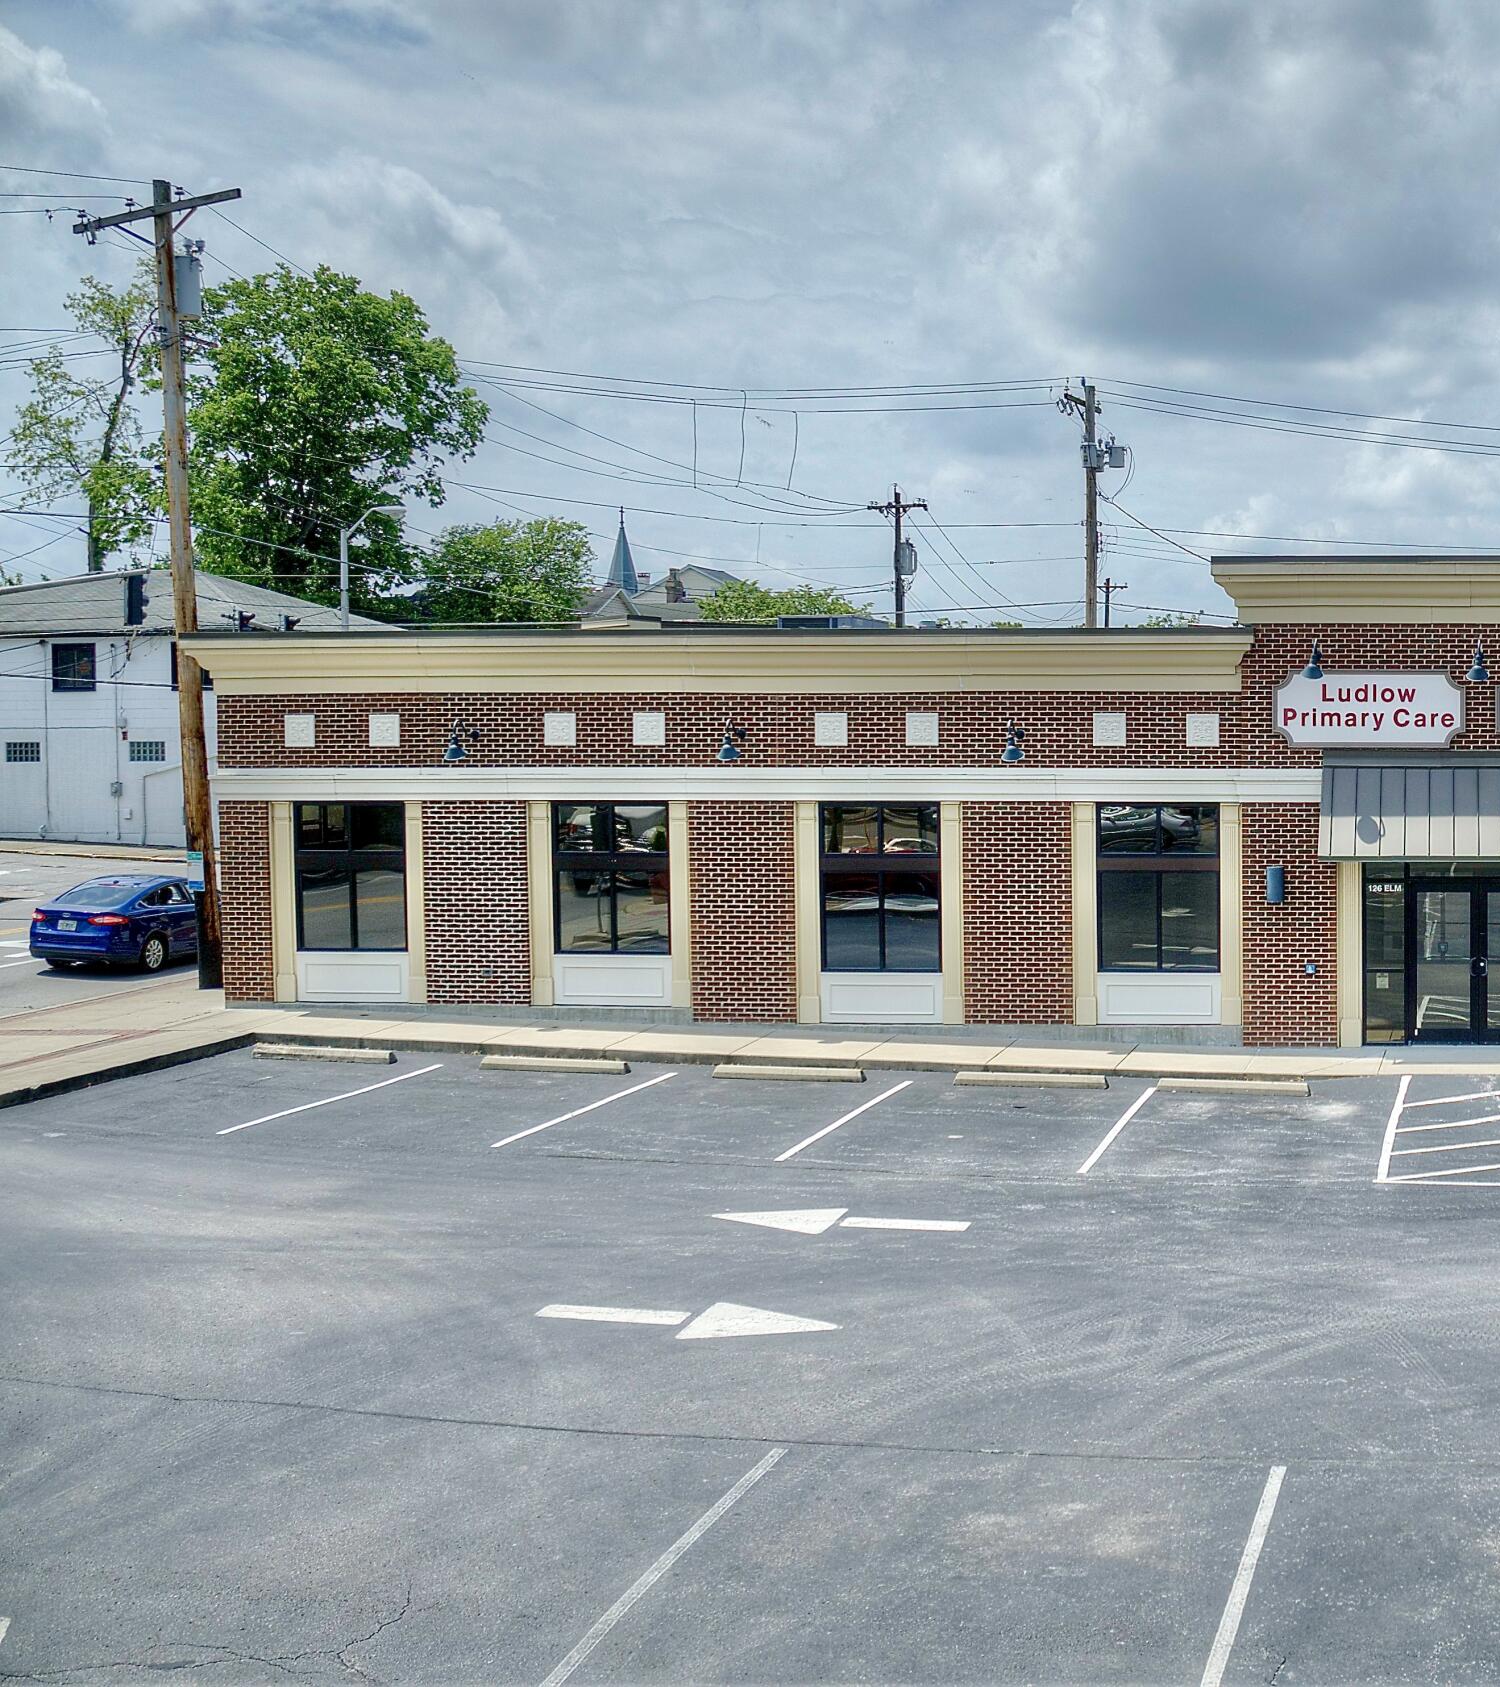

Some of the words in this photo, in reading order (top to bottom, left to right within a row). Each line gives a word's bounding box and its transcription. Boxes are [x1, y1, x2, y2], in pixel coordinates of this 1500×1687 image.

[1321, 683, 1416, 703] Ludlow
[1283, 708, 1384, 731] Primary
[1393, 708, 1455, 728] Care
[1368, 884, 1382, 892] 126
[1384, 884, 1402, 892] ELM
